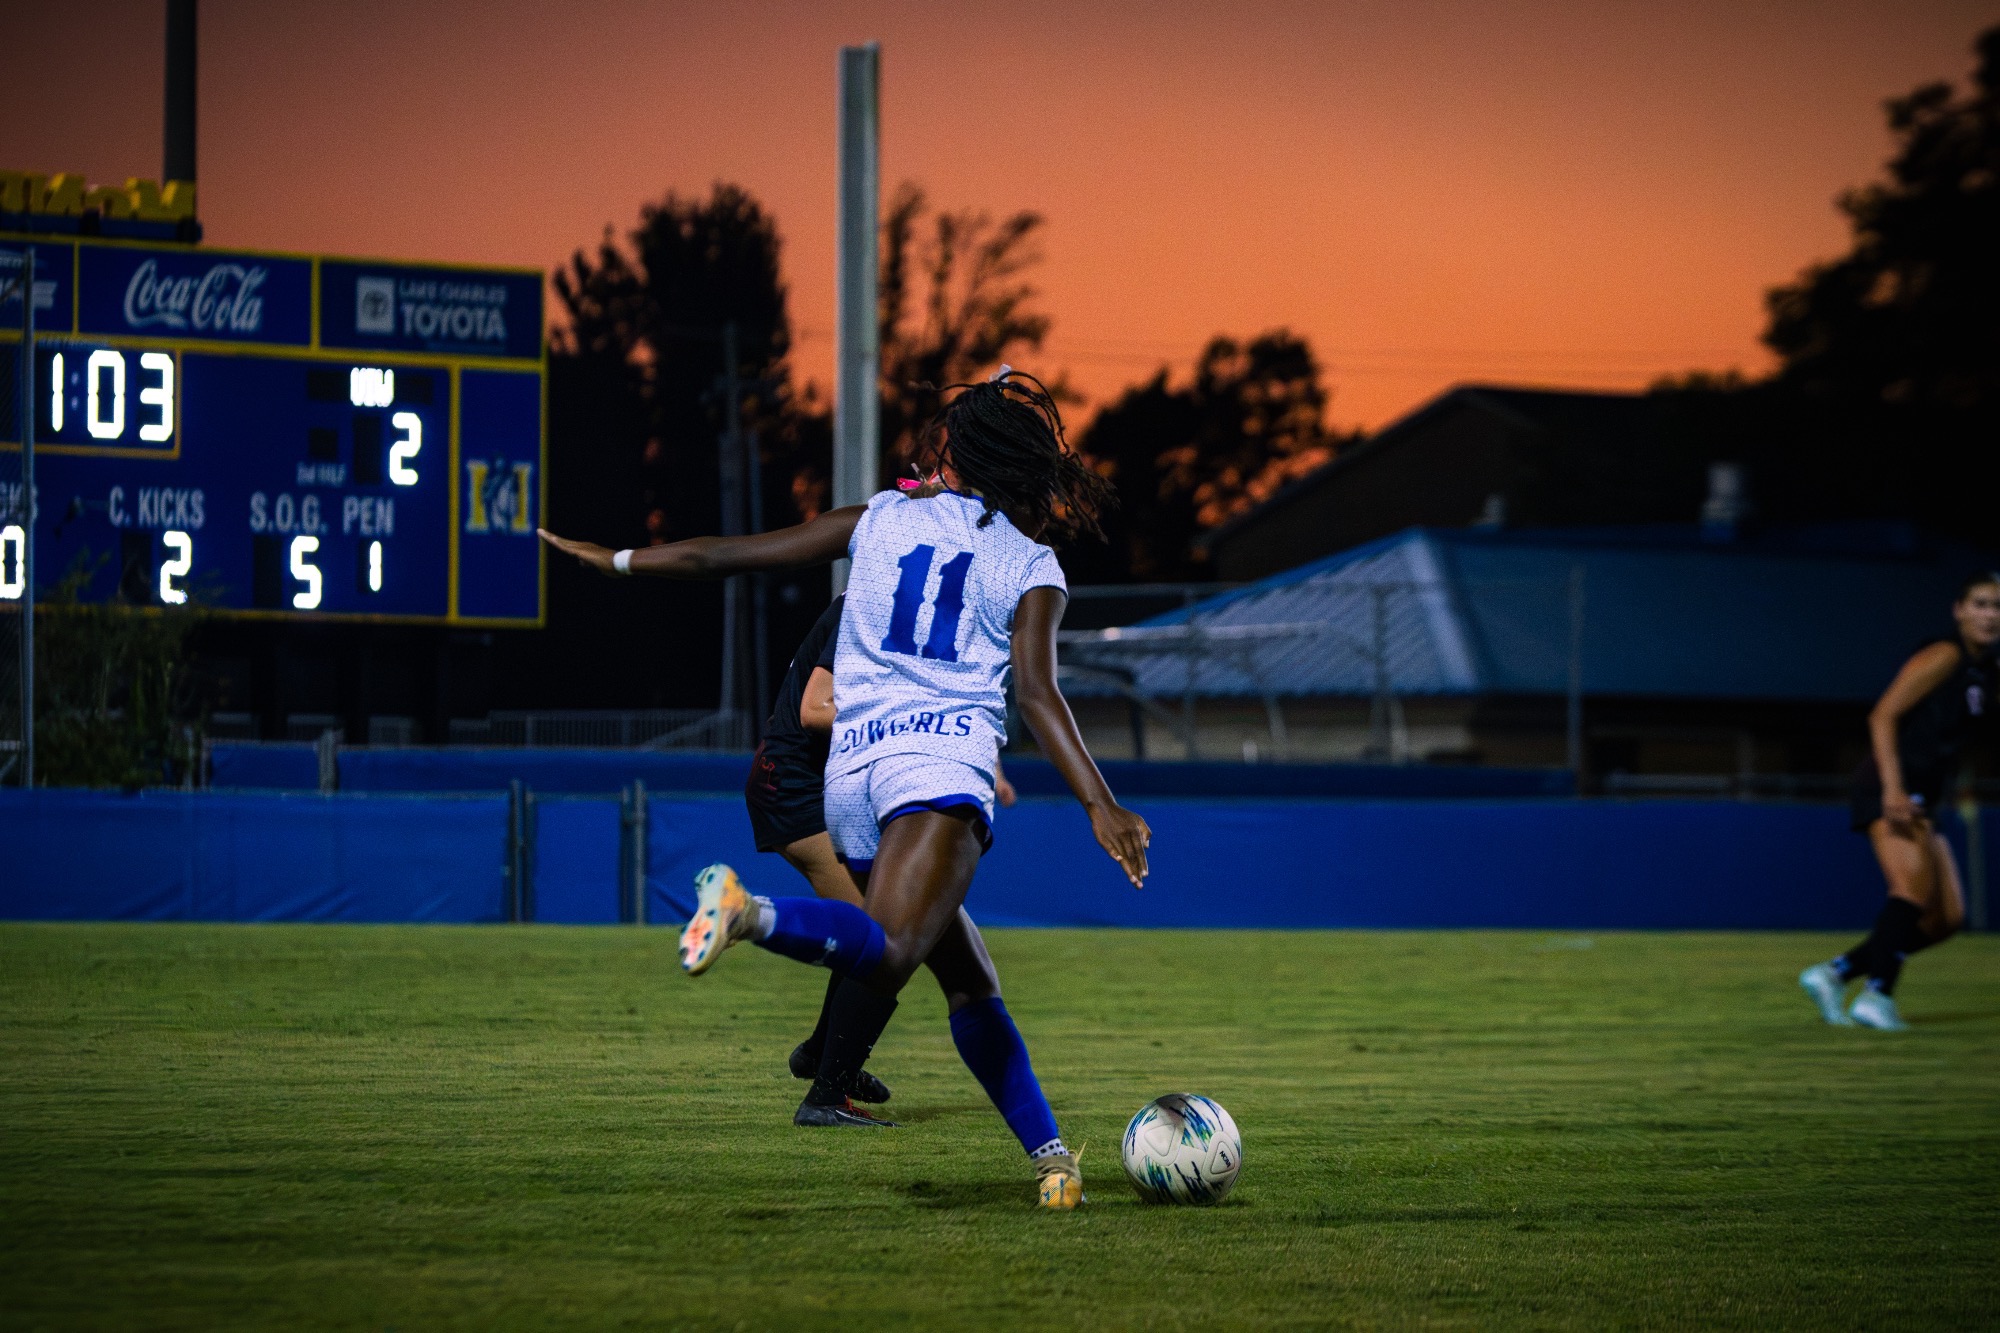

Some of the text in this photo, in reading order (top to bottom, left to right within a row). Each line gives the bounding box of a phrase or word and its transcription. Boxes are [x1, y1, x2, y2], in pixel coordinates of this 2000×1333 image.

[400, 302, 507, 341] TOYOTA
[389, 411, 422, 486] 2
[138, 487, 206, 529] KICKS
[250, 491, 329, 534] S.O.G.
[342, 495, 396, 536] PEN
[160, 530, 192, 605] 2
[290, 535, 322, 609] 5
[369, 540, 382, 592] 1
[880, 543, 975, 663] 11
